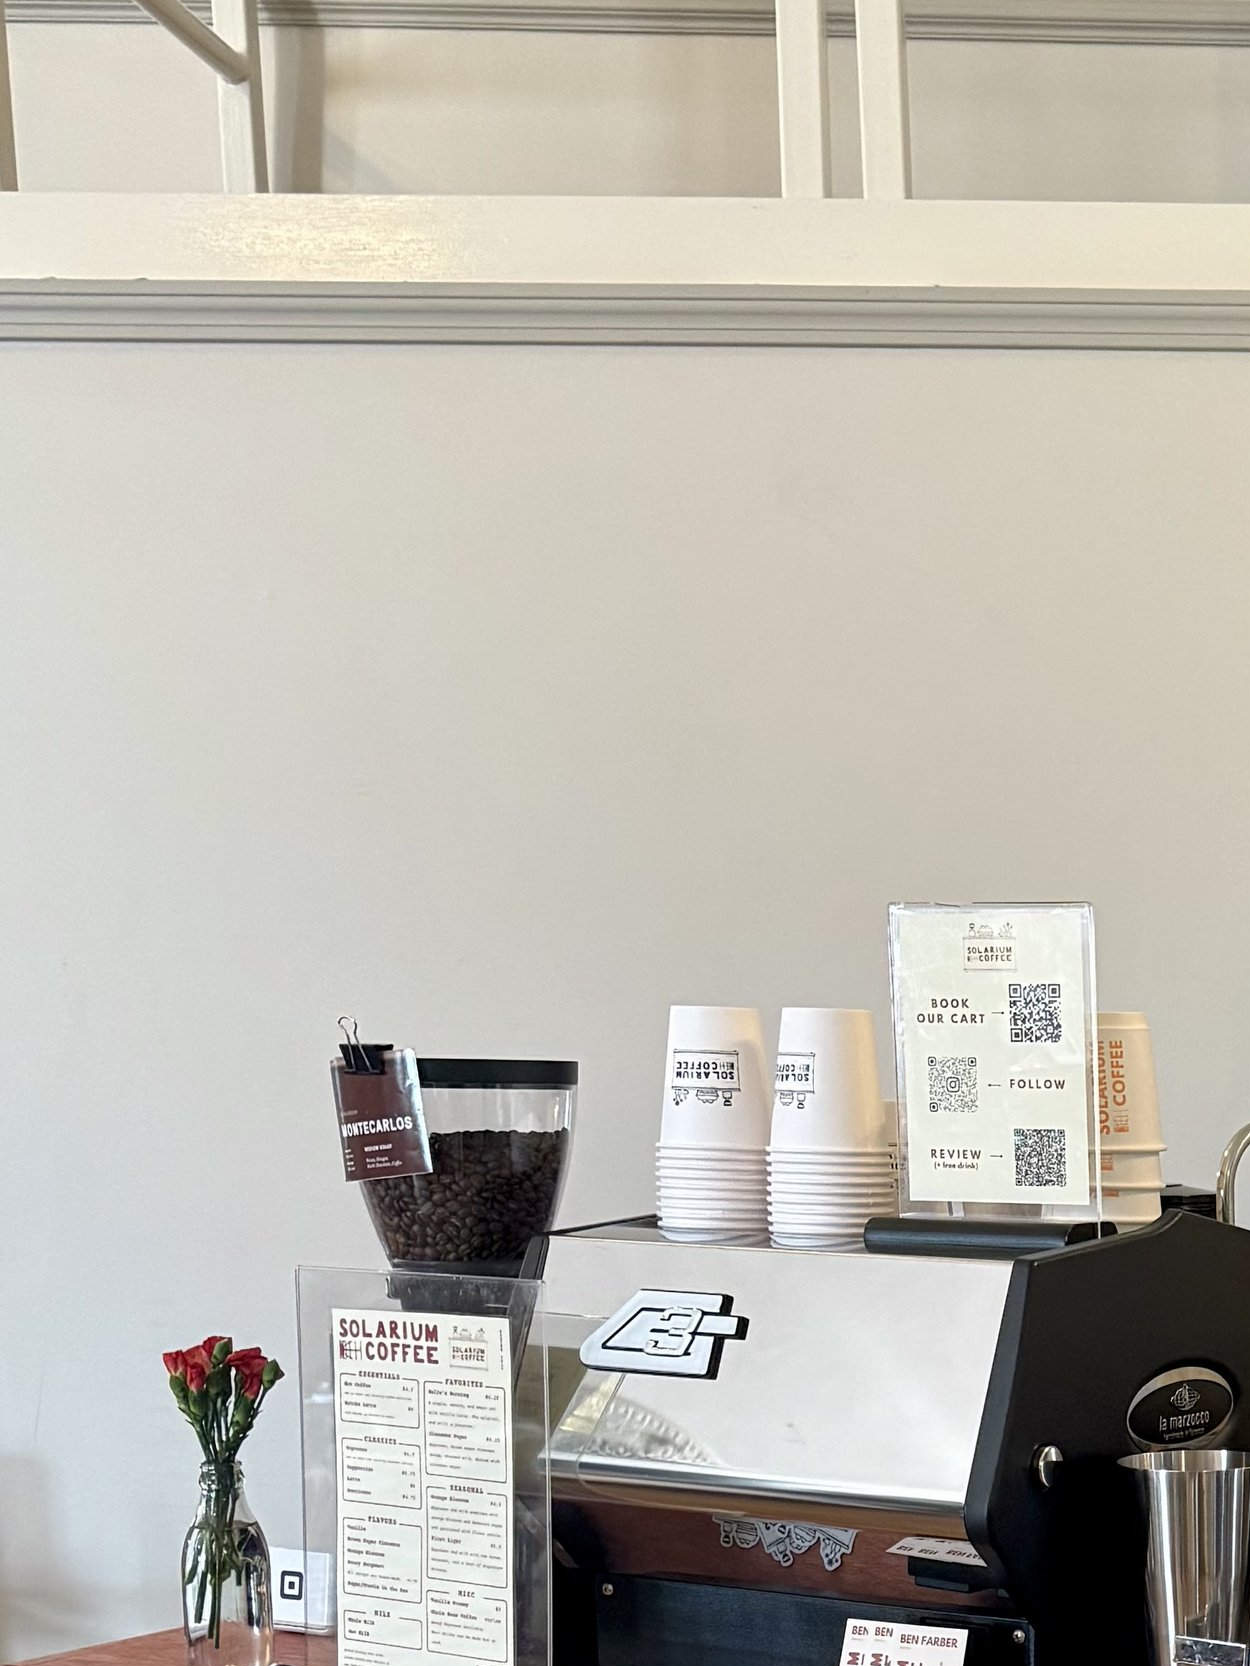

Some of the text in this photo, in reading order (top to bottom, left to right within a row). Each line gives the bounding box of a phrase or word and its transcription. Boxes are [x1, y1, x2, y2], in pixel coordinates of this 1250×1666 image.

[967, 947, 1012, 955] SOLARIUM
[979, 954, 1012, 962] COFFEE
[931, 998, 970, 1009] BOOK
[917, 1013, 985, 1024] OUR CART
[676, 1061, 718, 1070] COFFEE
[676, 1071, 734, 1080] SOLARIUM
[1109, 1040, 1126, 1106] COFFEE
[1009, 1079, 1066, 1090] FOLLOW
[341, 1116, 413, 1138] MONTECARLOS
[930, 1149, 981, 1160] REVIEW
[339, 1318, 439, 1343] SOLARIUM
[365, 1341, 439, 1365] COFFEE
[1159, 1411, 1210, 1431] la marzocco
[851, 1626, 869, 1635] BEN
[874, 1626, 894, 1637] BEN
[899, 1633, 958, 1648] BEN FARBER
